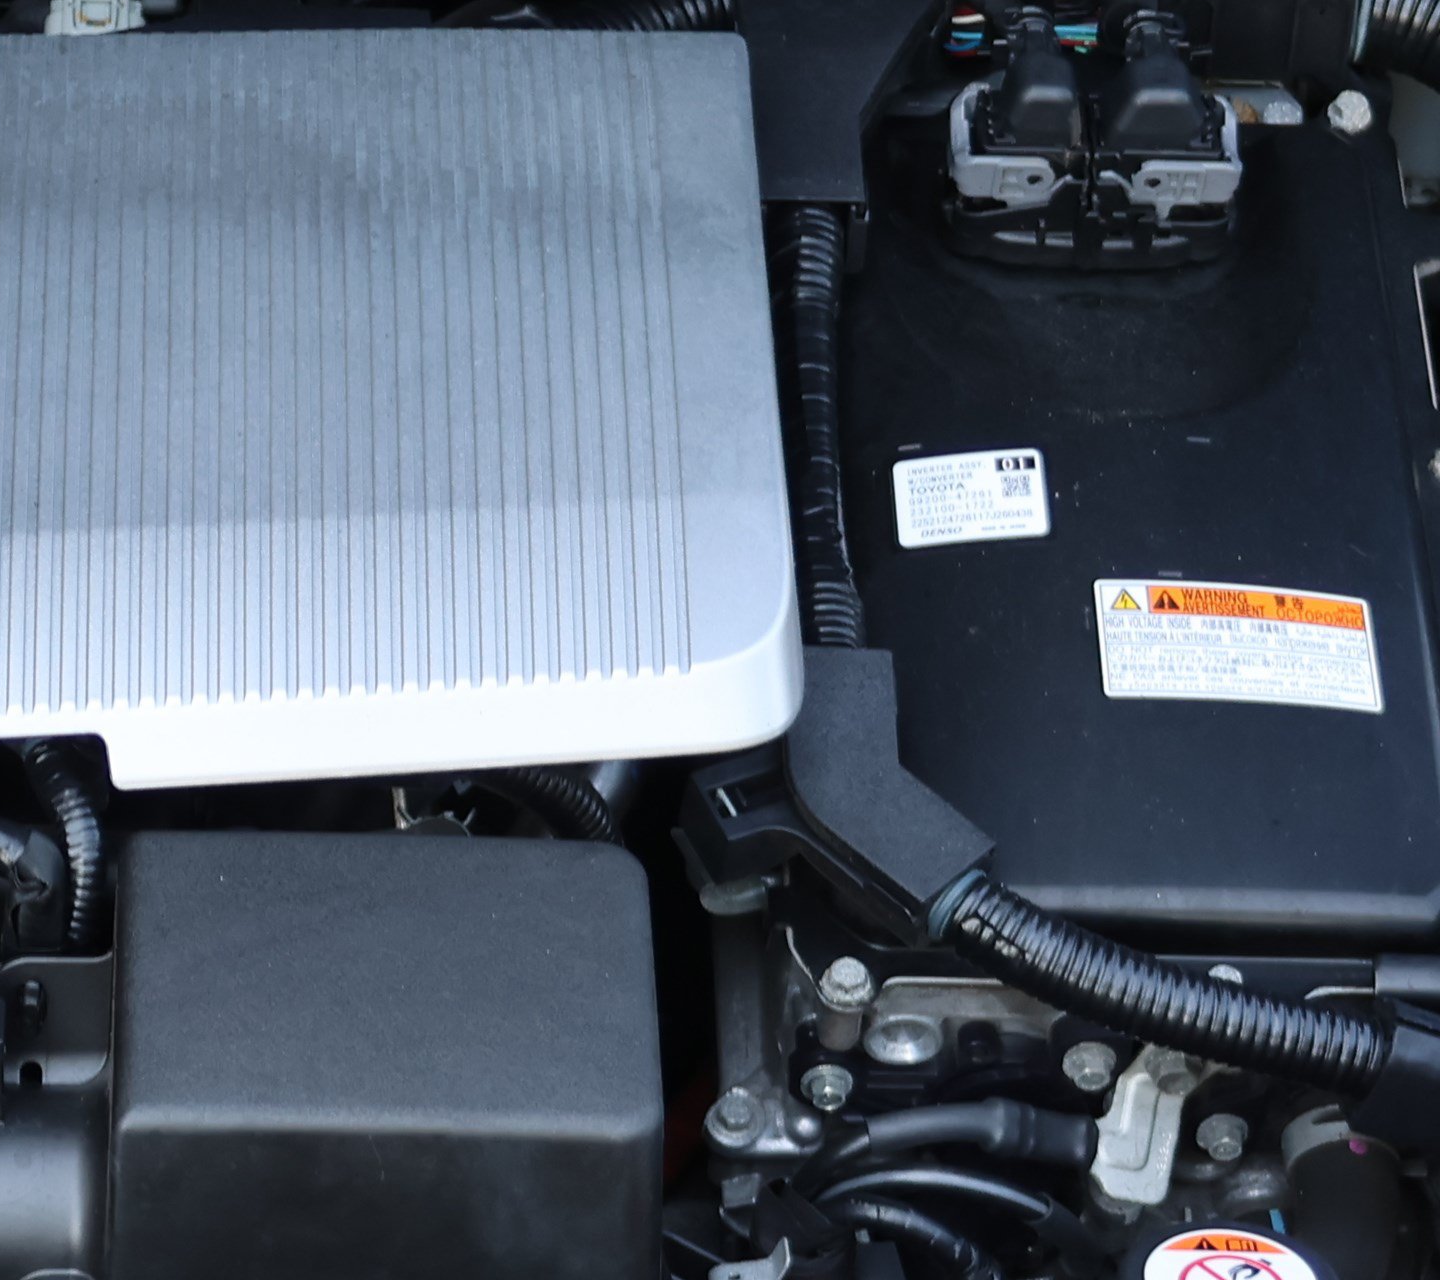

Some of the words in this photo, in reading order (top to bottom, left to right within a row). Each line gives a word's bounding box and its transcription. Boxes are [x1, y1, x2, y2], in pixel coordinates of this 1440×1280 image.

[909, 482, 966, 496] TOYOTA
[920, 526, 963, 538] DENSO
[1181, 588, 1248, 604] WARNING
[1182, 601, 1265, 617] AVERTISSEMENT
[1105, 616, 1125, 629] HIGH
[1128, 616, 1163, 629] VOLTAGE
[1167, 617, 1192, 630] INSIDE
[1276, 608, 1364, 629] ОСТОРОЖНО
[1106, 631, 1131, 643] HAUTE
[1134, 631, 1167, 643] TENSION
